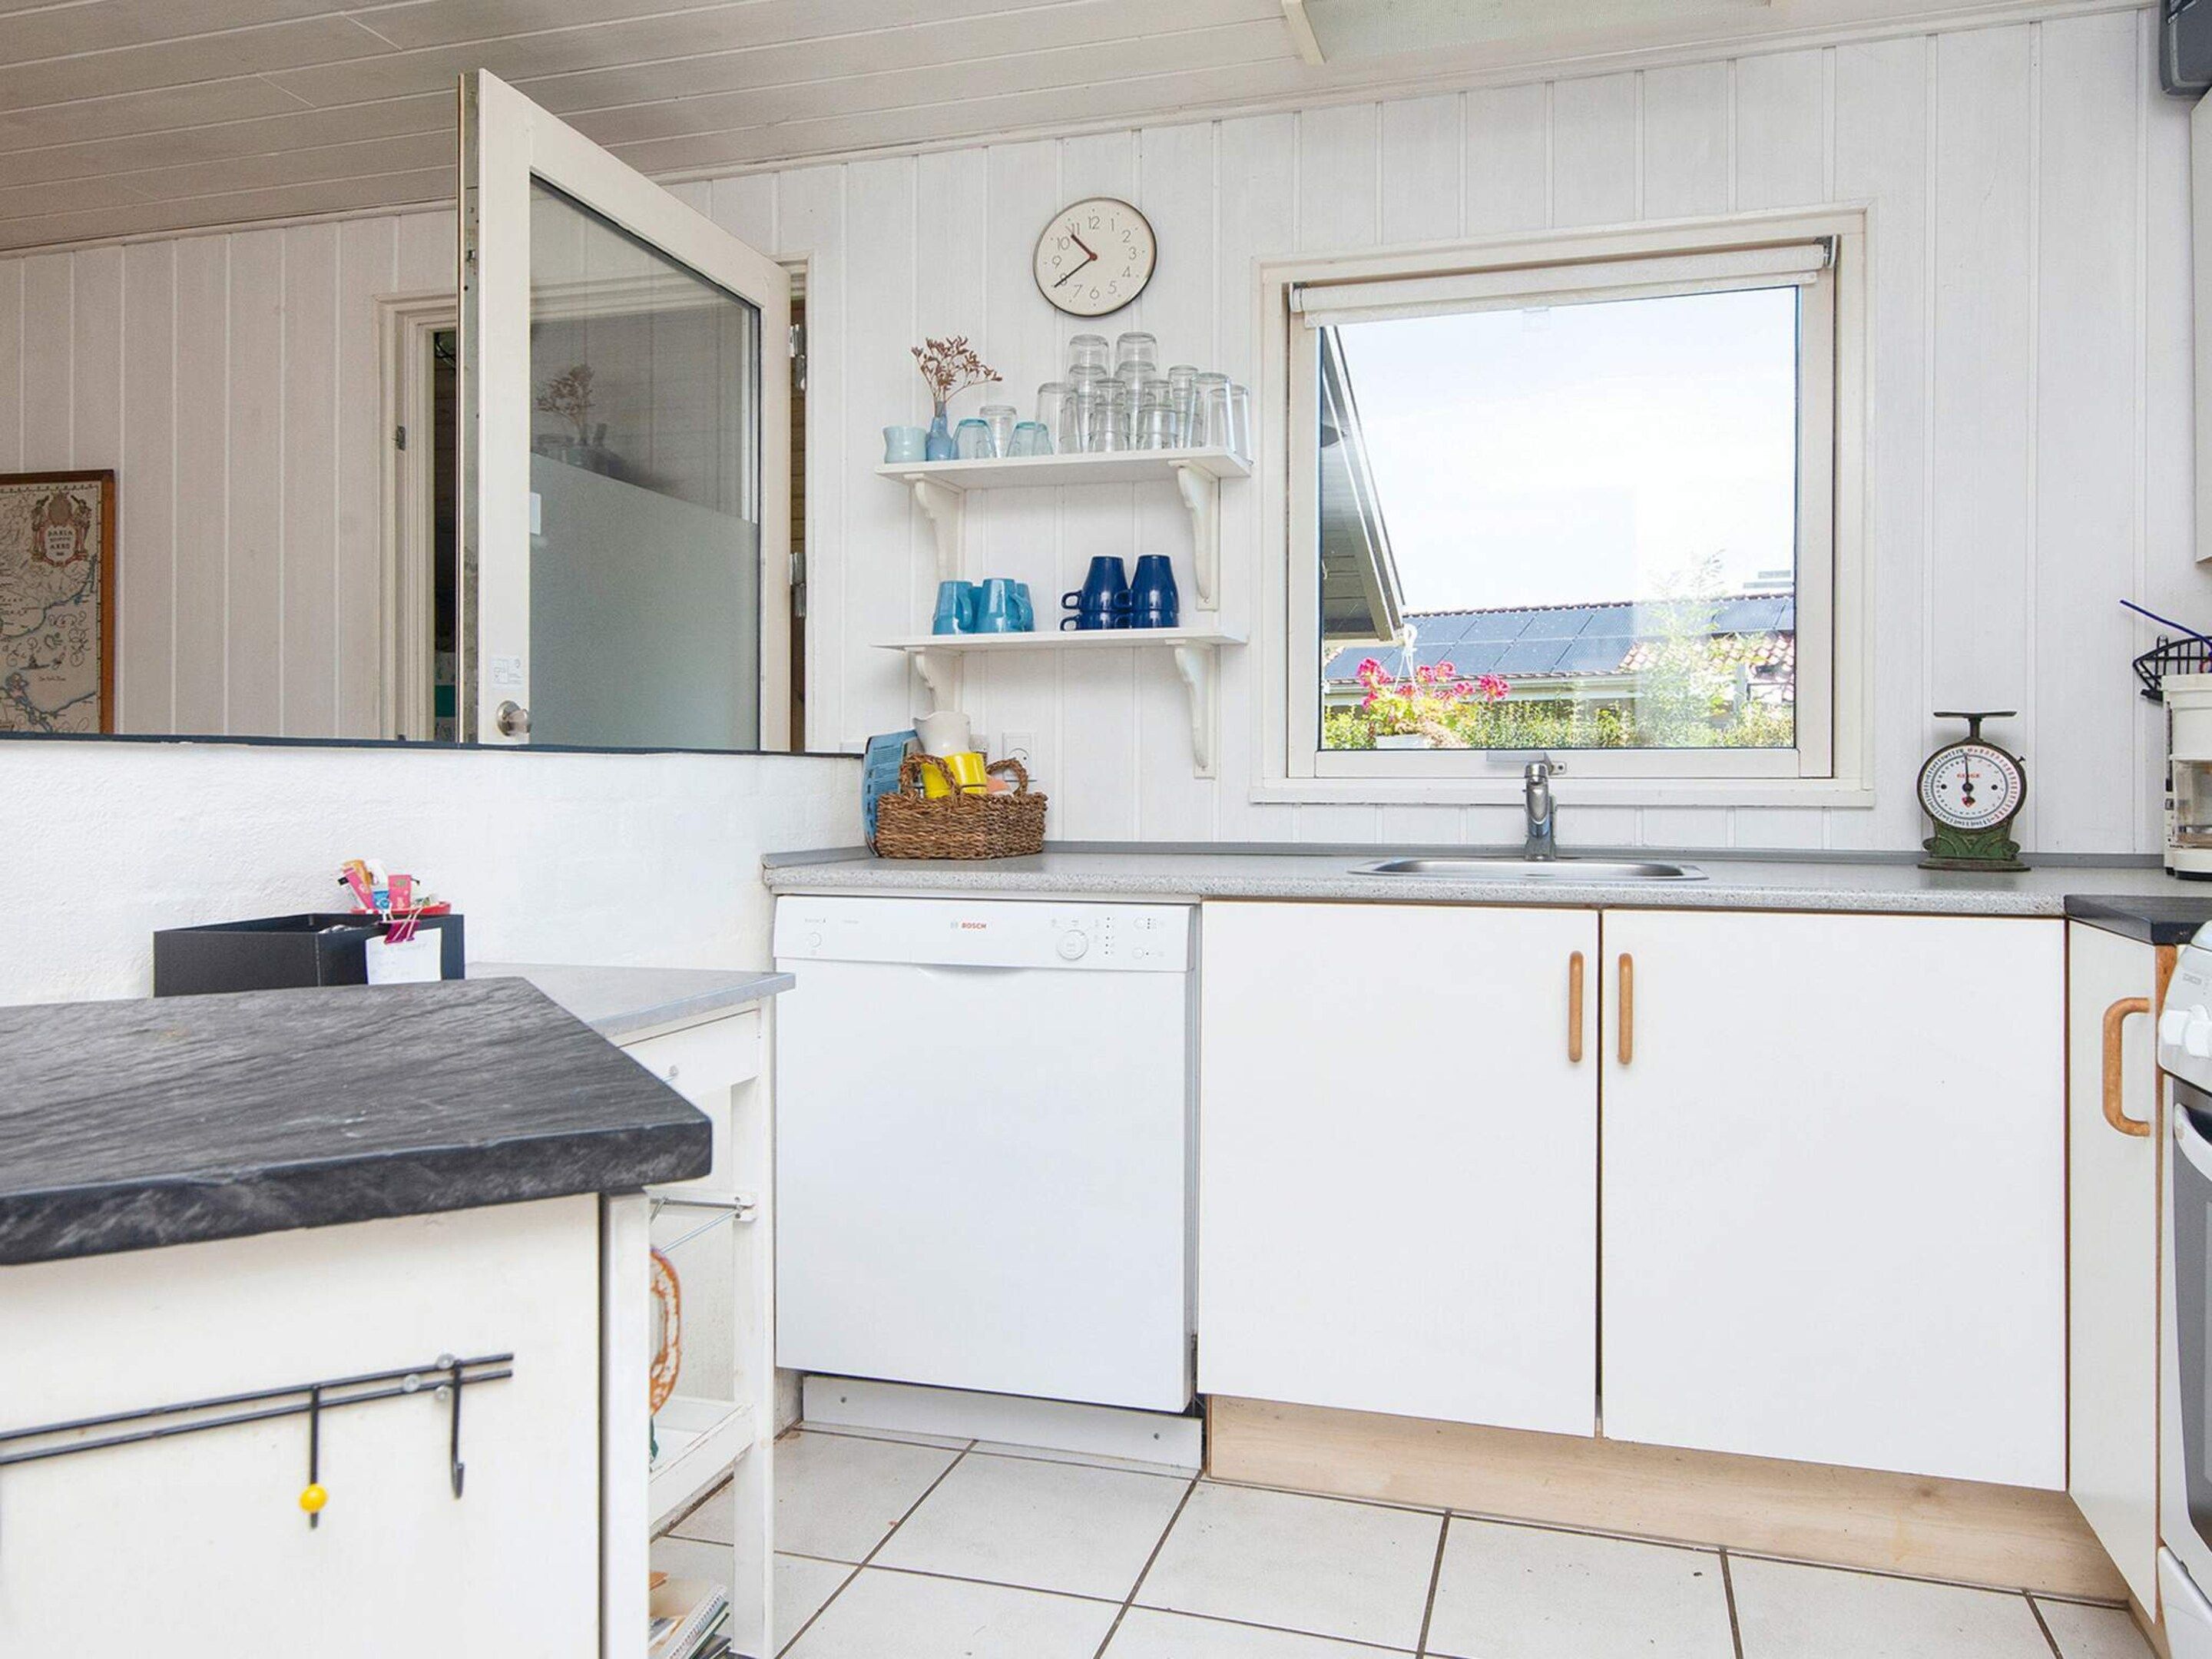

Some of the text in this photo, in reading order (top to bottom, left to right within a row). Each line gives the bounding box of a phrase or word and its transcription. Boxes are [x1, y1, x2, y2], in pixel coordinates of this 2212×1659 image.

[1088, 216, 1101, 230] 12
[1111, 218, 1114, 231] 1
[1057, 236, 1070, 250] 10
[1121, 230, 1131, 243] 2
[1128, 247, 1137, 260] 3
[1051, 255, 1062, 269] 9
[1122, 266, 1131, 277] 4
[1059, 273, 1068, 286] 8
[1074, 284, 1083, 298] 7
[1089, 286, 1100, 300] 6
[1108, 280, 1117, 294] 5
